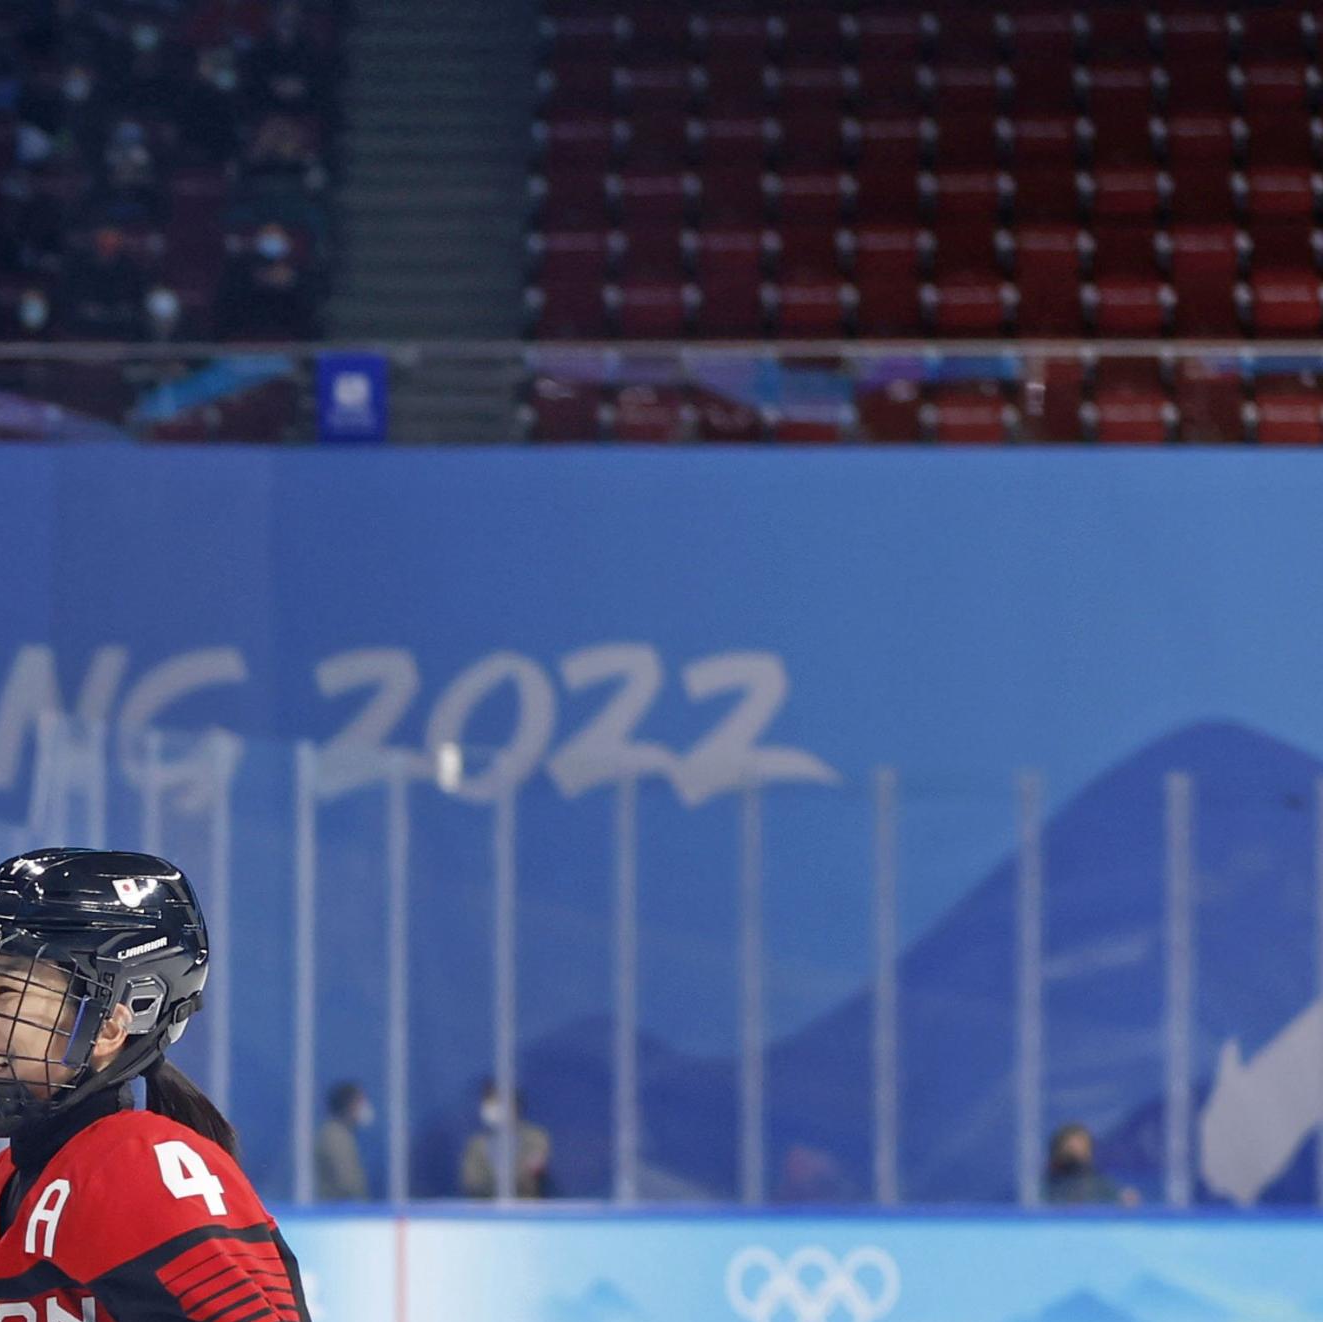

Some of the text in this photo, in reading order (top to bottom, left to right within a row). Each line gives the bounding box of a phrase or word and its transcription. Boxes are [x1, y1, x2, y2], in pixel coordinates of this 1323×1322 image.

[314, 640, 845, 810] 2022
[24, 1178, 71, 1258] A
[153, 1140, 228, 1216] 4
